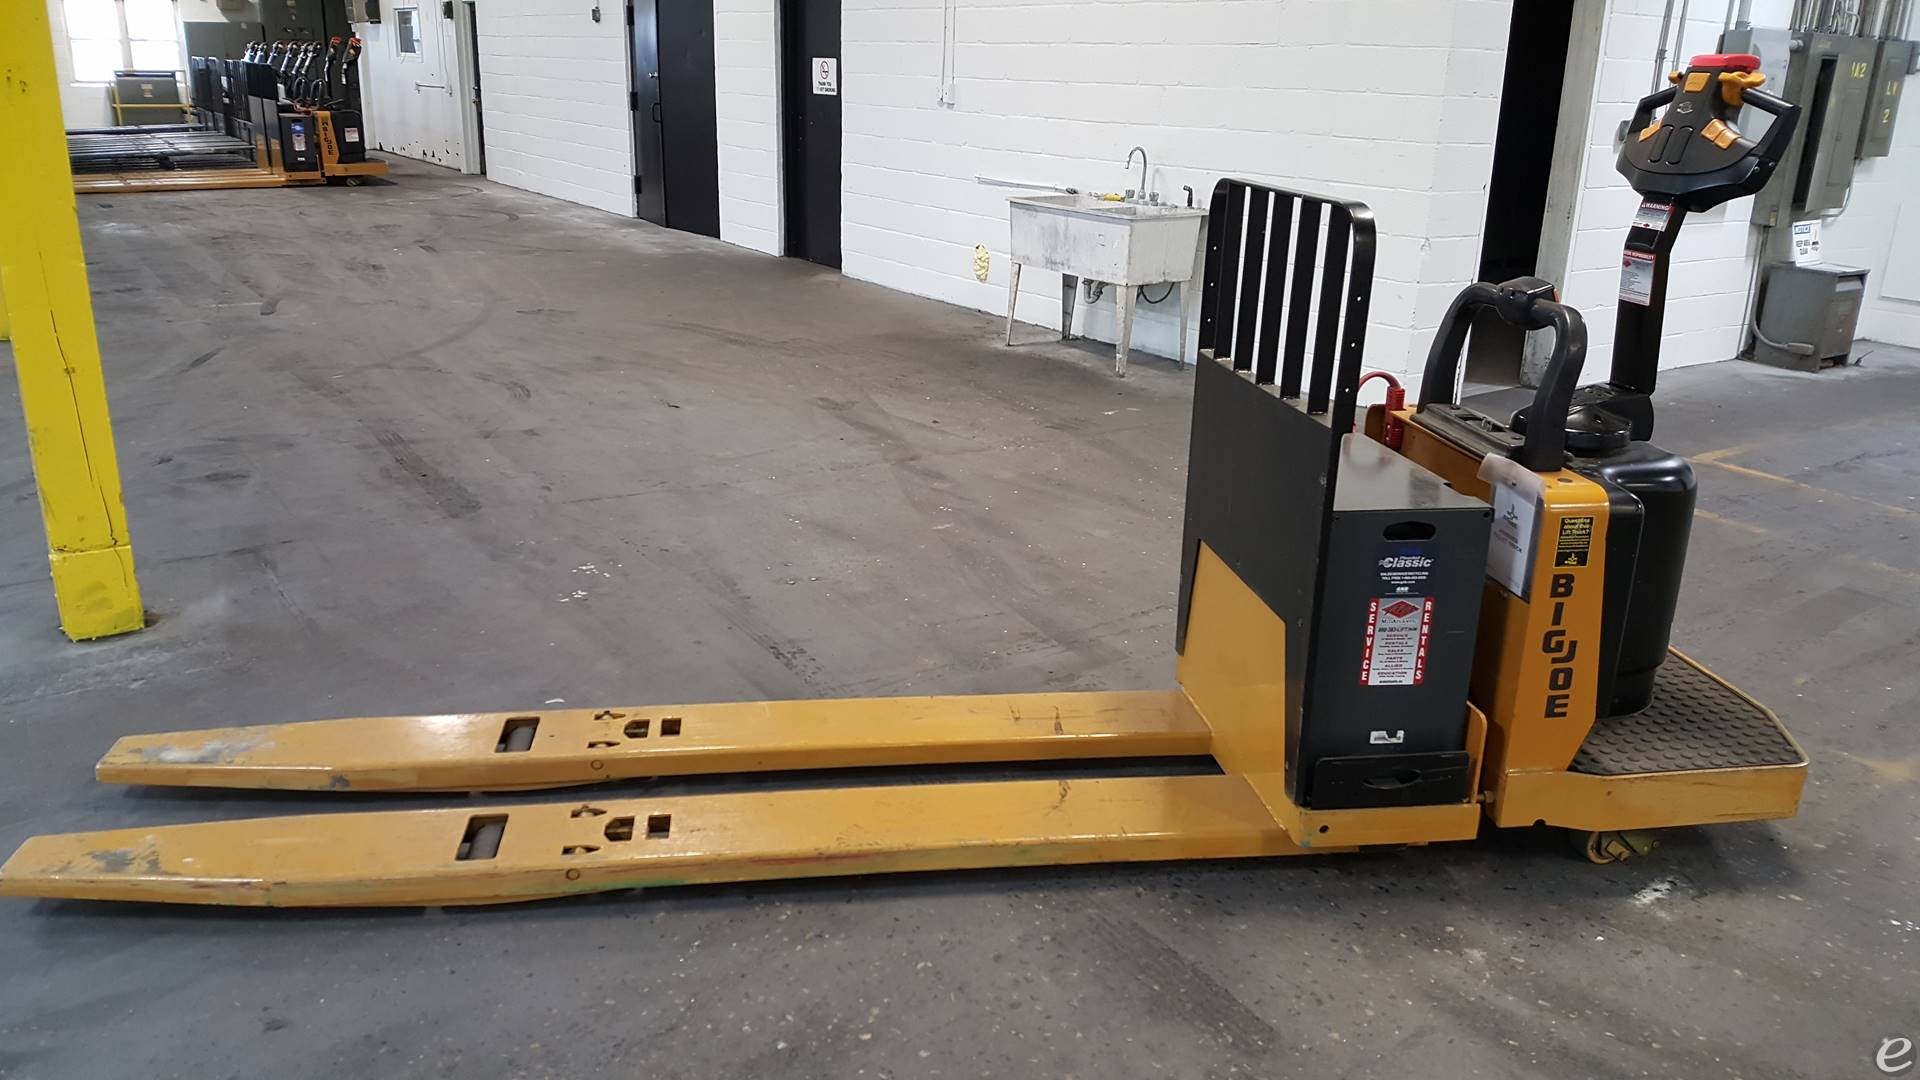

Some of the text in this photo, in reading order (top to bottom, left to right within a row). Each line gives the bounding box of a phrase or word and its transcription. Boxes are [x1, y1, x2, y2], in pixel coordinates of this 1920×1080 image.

[1384, 557, 1431, 568] Classic
[1361, 602, 1377, 681] SERVICE
[1415, 601, 1432, 680] RENTALS
